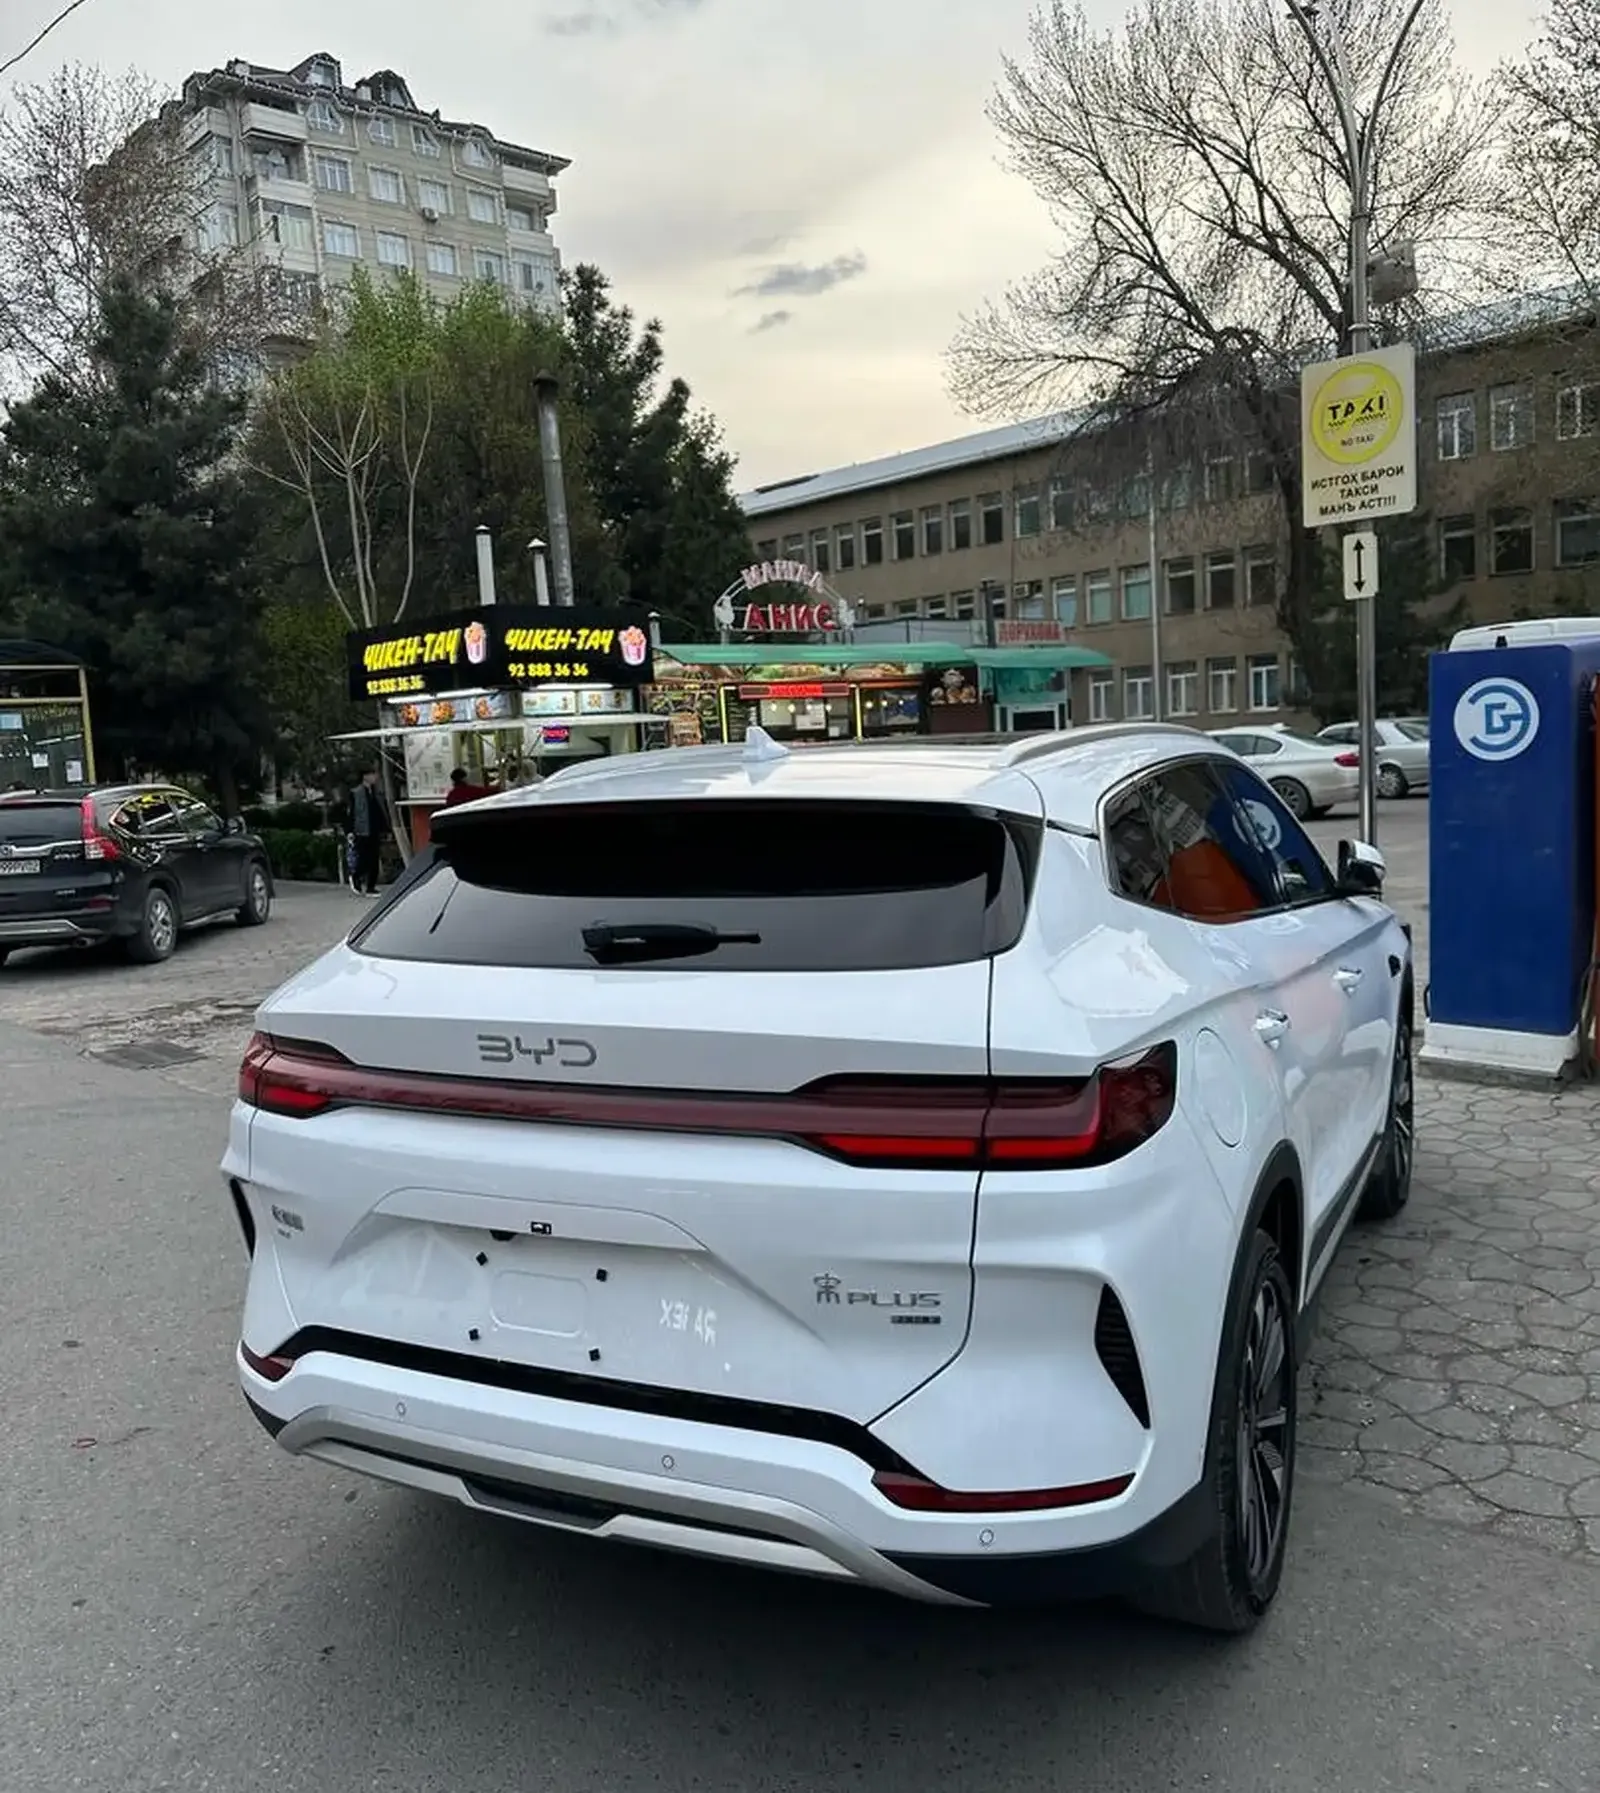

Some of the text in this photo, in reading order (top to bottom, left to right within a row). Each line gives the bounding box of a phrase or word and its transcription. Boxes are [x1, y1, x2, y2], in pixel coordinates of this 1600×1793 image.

[1361, 465, 1404, 481] БАРОИ
[1339, 483, 1379, 499] ТАКСИ
[743, 601, 837, 632] АНИС
[364, 628, 461, 672] ЧИКЕН-ТАЧ
[505, 628, 615, 654] ЧИКЕН-ТАЧ
[508, 663, 589, 677] 92 888 36 36
[478, 1034, 597, 1067] BYD
[847, 1291, 941, 1307] PLUS
